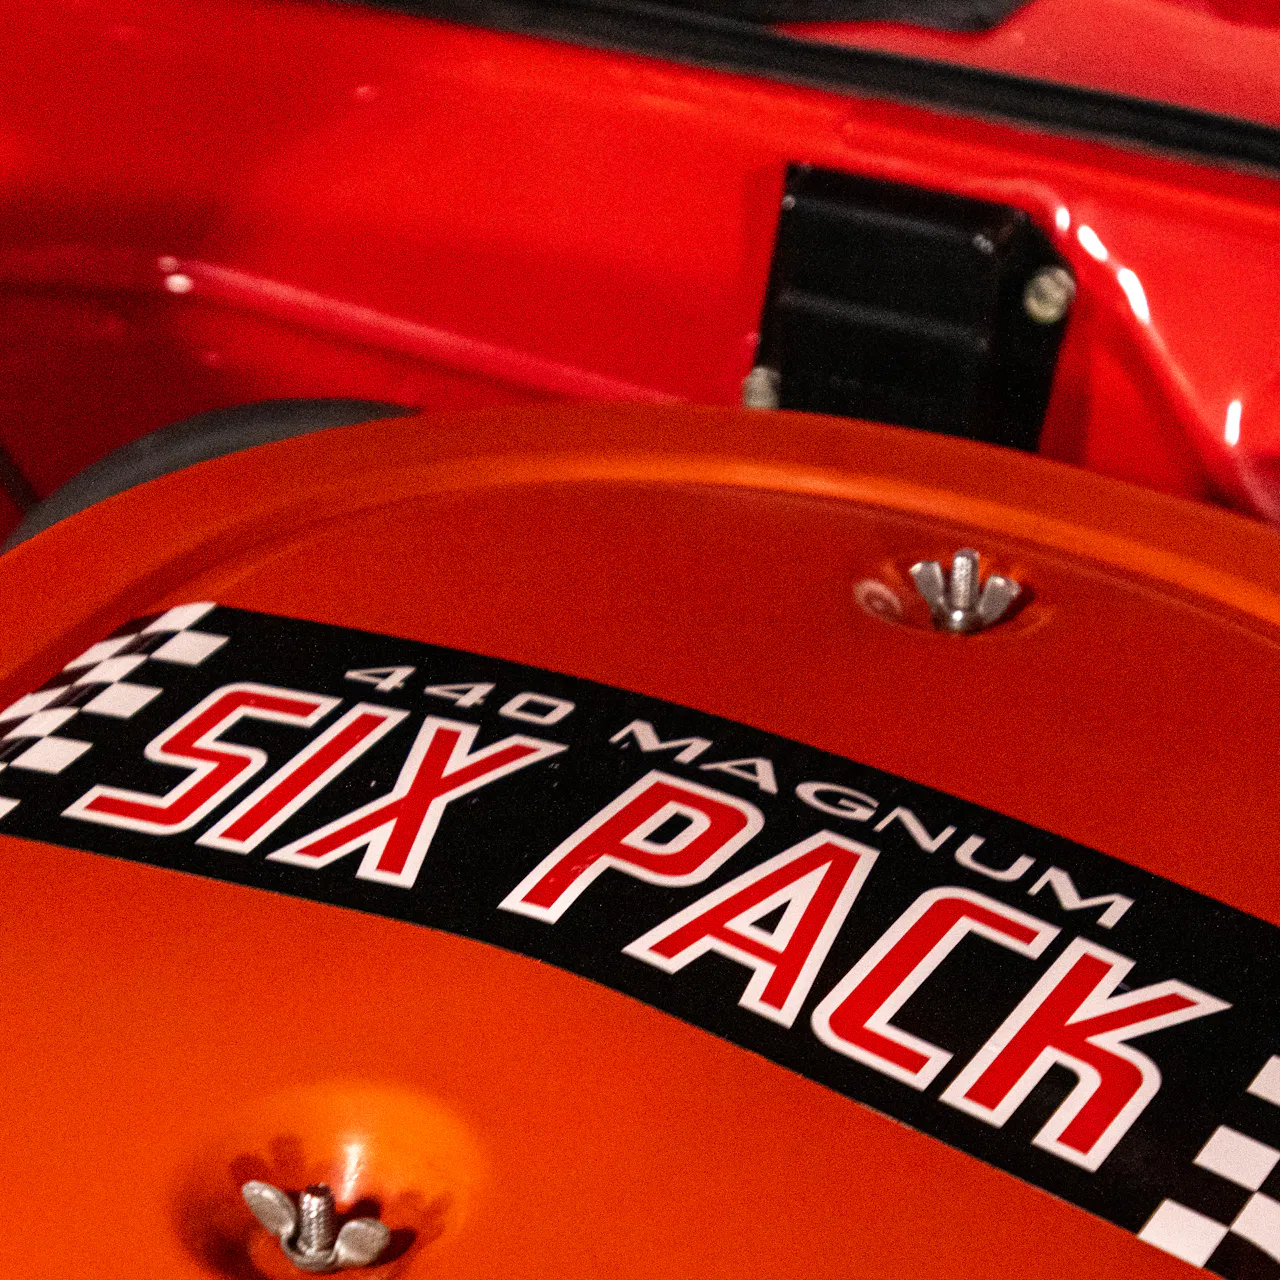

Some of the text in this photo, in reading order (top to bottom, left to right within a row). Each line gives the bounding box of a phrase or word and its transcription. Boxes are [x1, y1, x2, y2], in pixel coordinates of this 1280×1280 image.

[61, 681, 1231, 1173] SIX PACK
[343, 665, 1134, 930] 440 MAGNUM
